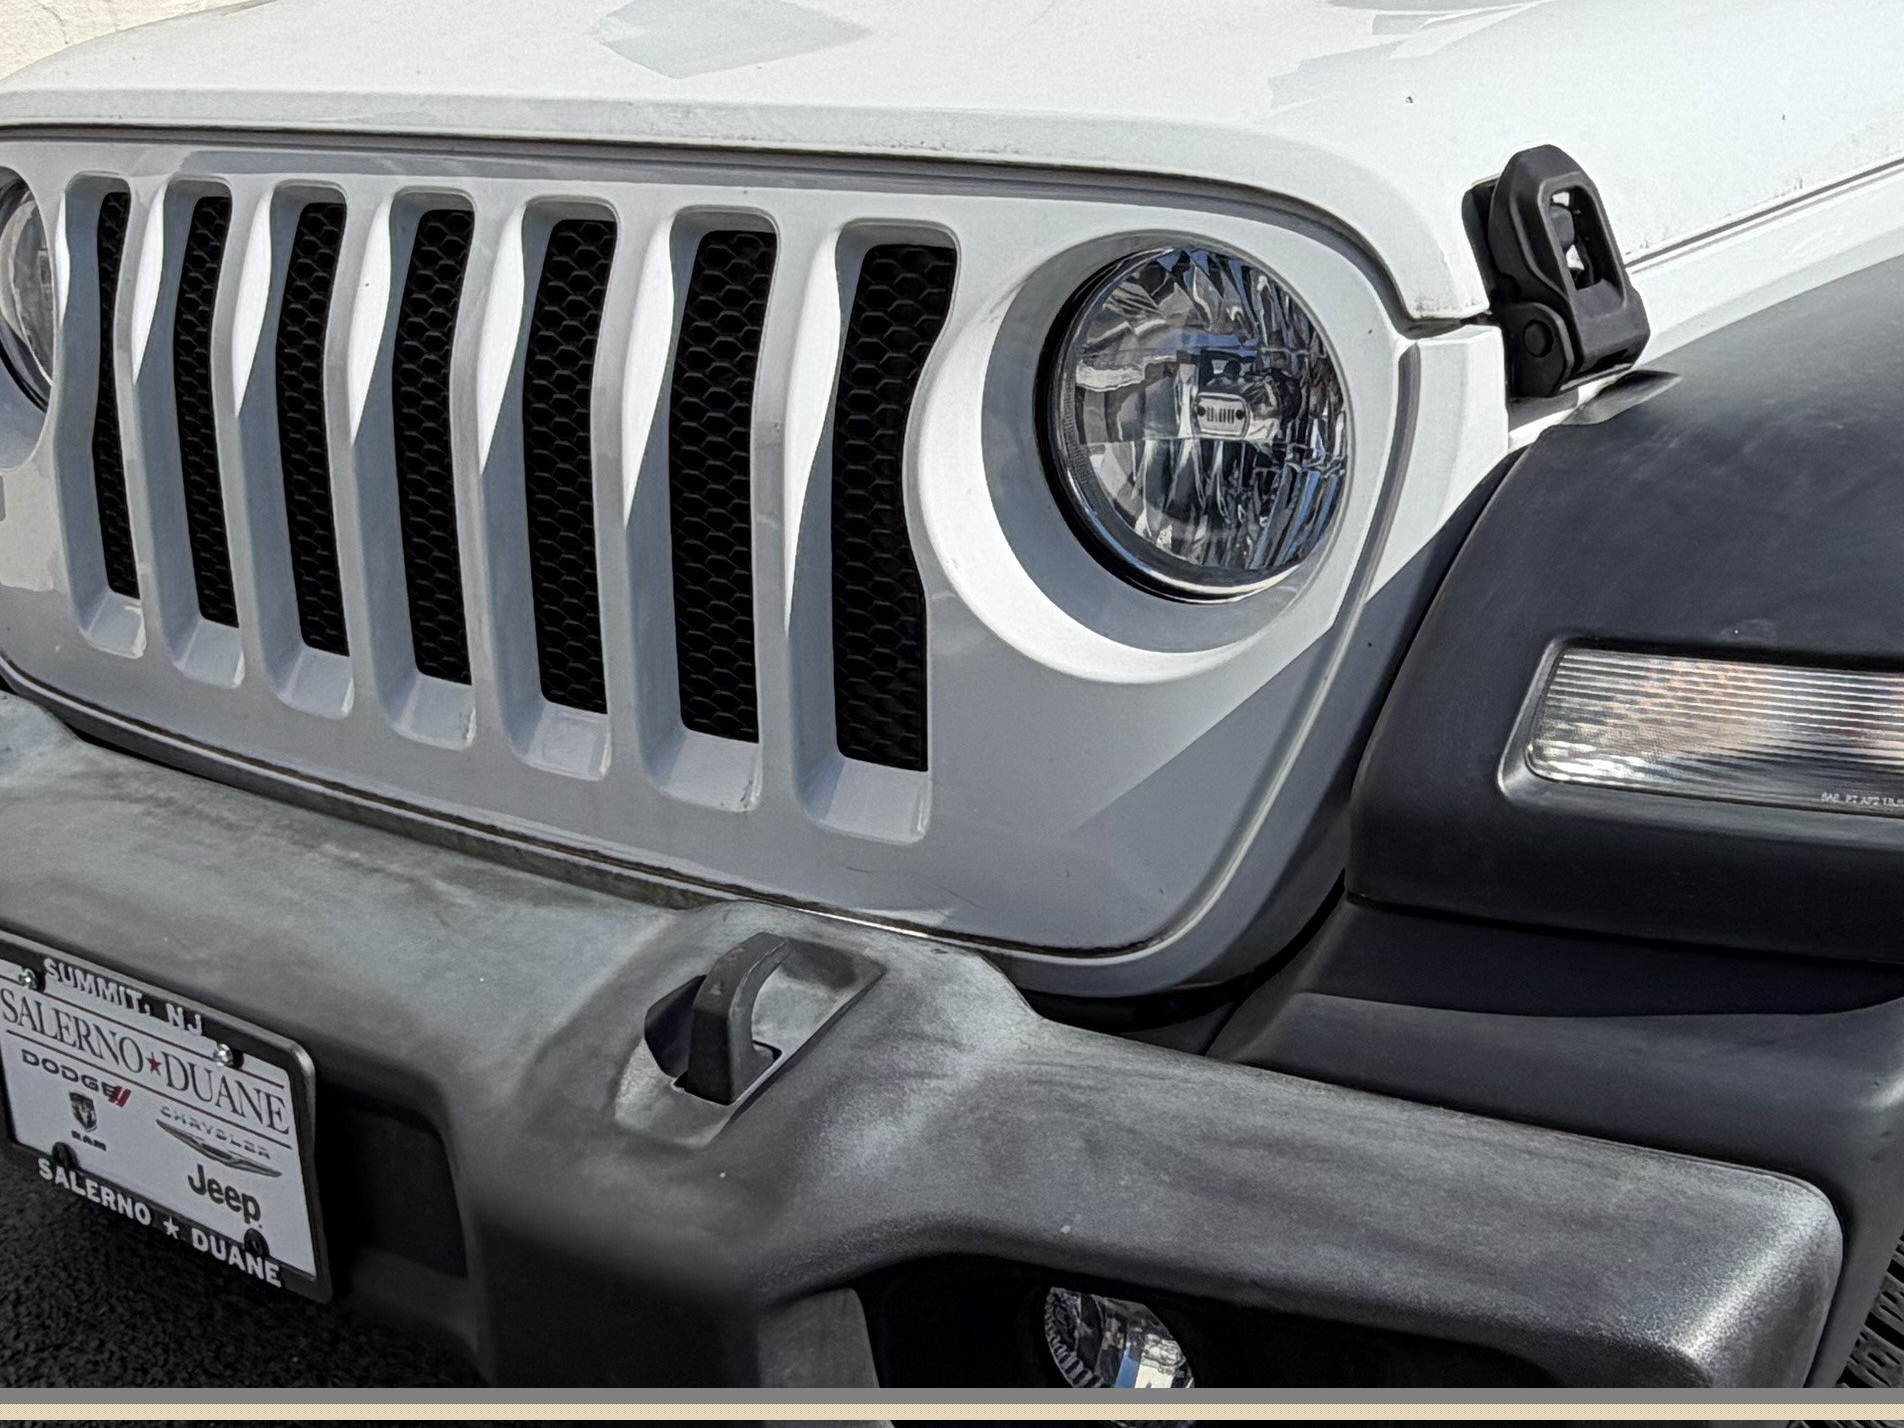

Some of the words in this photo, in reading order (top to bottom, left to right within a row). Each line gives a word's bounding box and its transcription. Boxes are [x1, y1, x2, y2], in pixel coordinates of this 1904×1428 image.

[166, 1002, 203, 1036] NJ
[0, 987, 145, 1074] SALERNO
[162, 1051, 291, 1135] DUANE
[21, 1049, 120, 1098] DODGE
[160, 1105, 271, 1160] CHRYSLER
[37, 1157, 153, 1227] SALERNO
[191, 1227, 283, 1288] DUANE
[187, 1163, 262, 1225] Jeep
